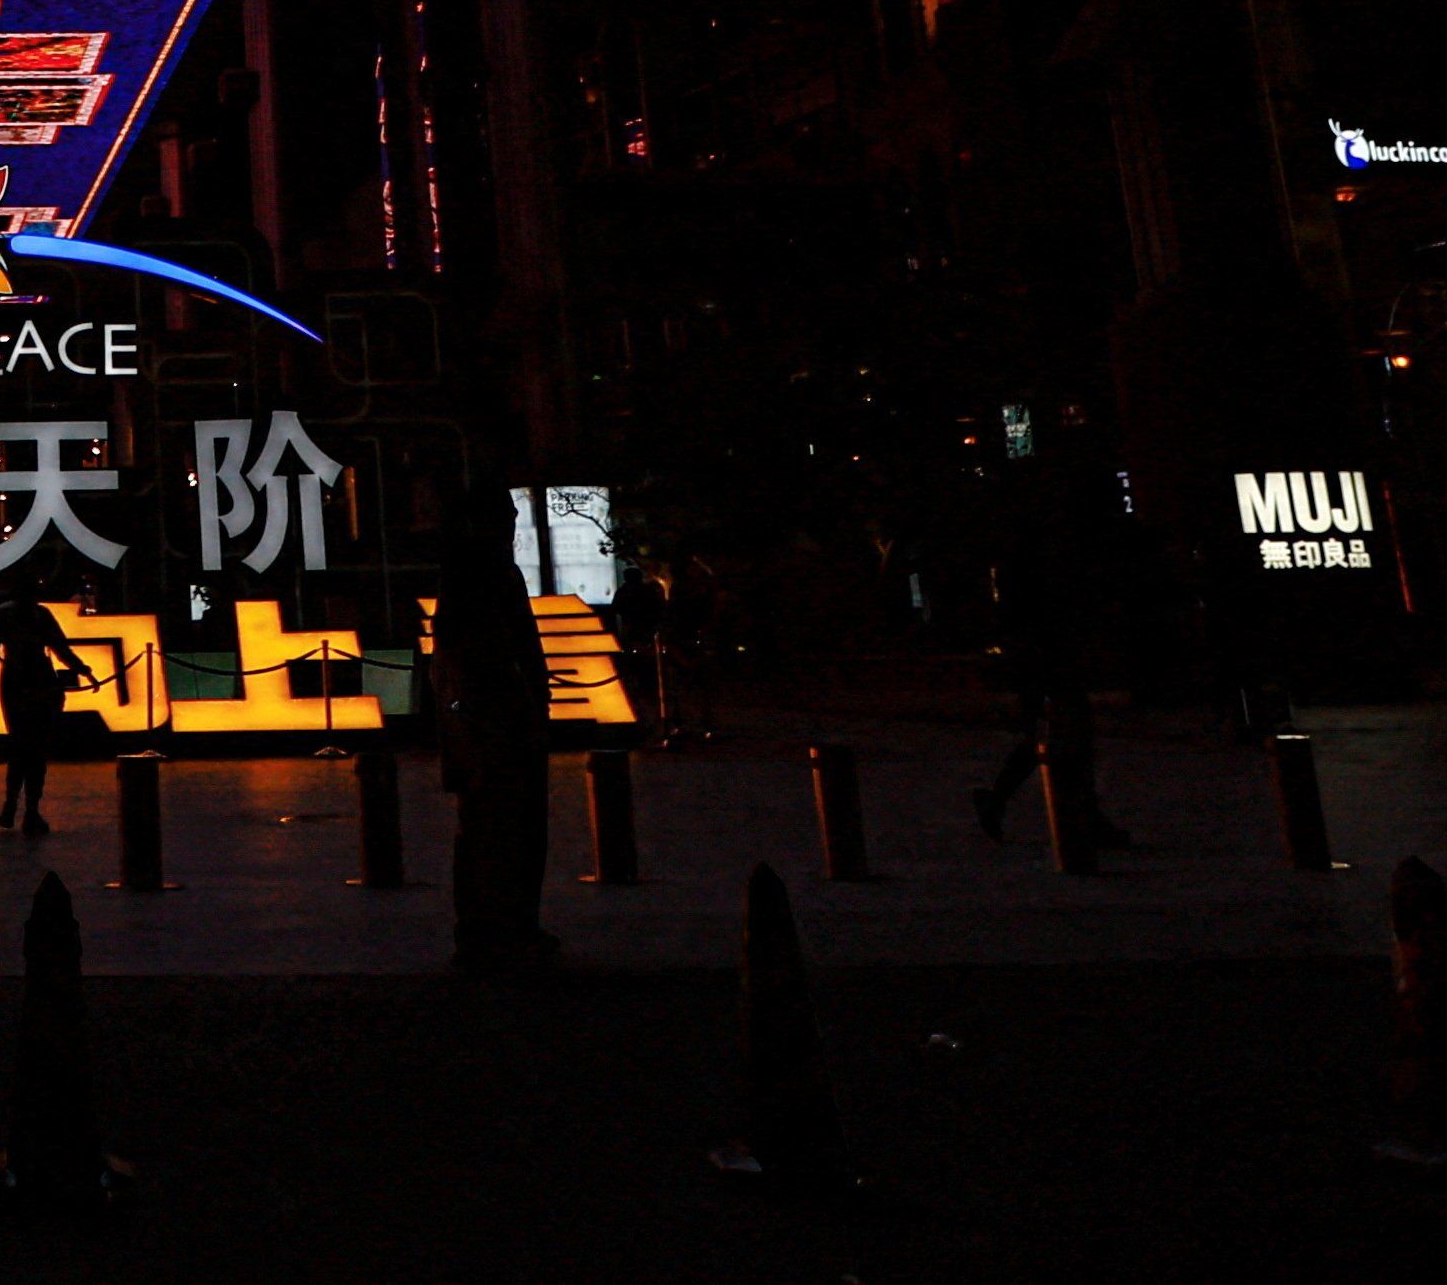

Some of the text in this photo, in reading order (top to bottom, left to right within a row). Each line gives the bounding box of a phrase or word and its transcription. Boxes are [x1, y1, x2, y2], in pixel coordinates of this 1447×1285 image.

[1234, 471, 1373, 533] MUJI
[1259, 538, 1372, 569] 無印良品
